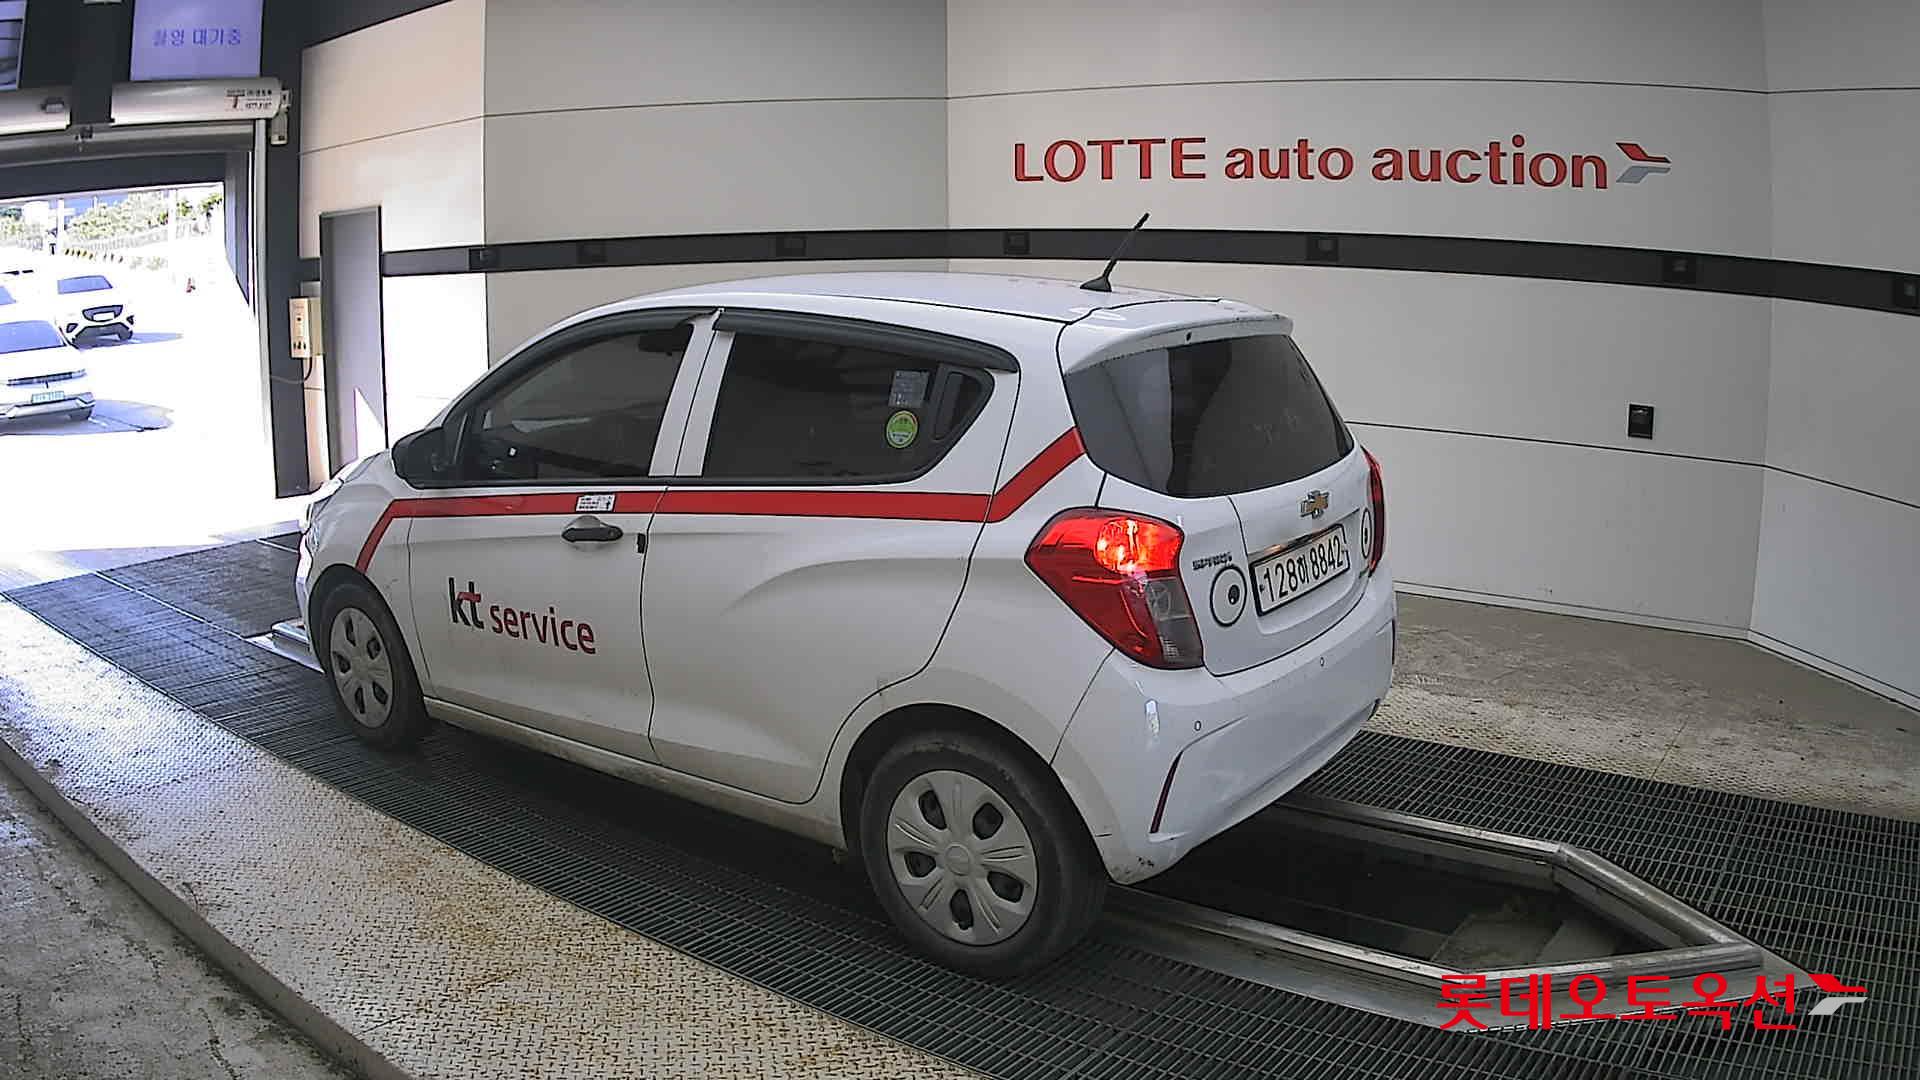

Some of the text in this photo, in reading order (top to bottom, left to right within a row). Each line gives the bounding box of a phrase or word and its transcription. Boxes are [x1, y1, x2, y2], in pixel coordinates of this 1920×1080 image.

[1014, 134, 1608, 189] LOTTE auto auction
[1309, 535, 1344, 580] 8842
[448, 577, 597, 655] kt service
